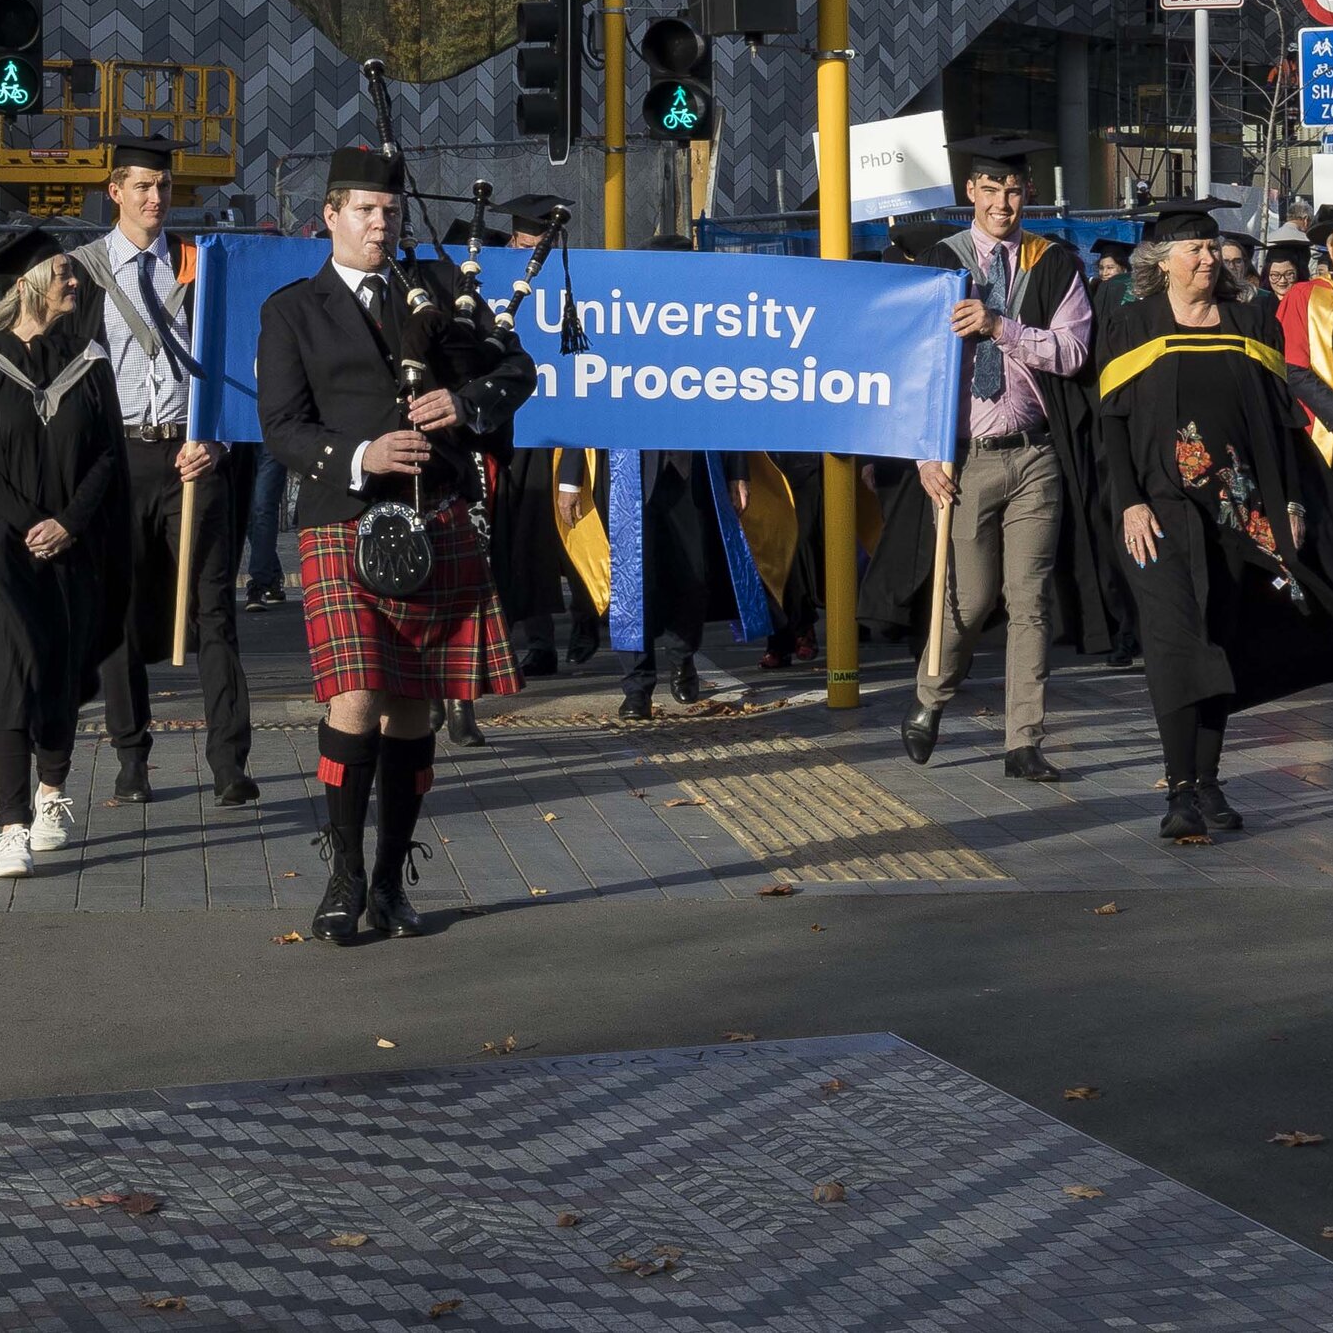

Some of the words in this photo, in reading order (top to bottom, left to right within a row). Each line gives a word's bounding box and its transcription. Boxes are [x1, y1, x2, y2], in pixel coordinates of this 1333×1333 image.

[860, 151, 905, 169] PhD's
[535, 288, 817, 349] University
[574, 353, 892, 406] Procession
